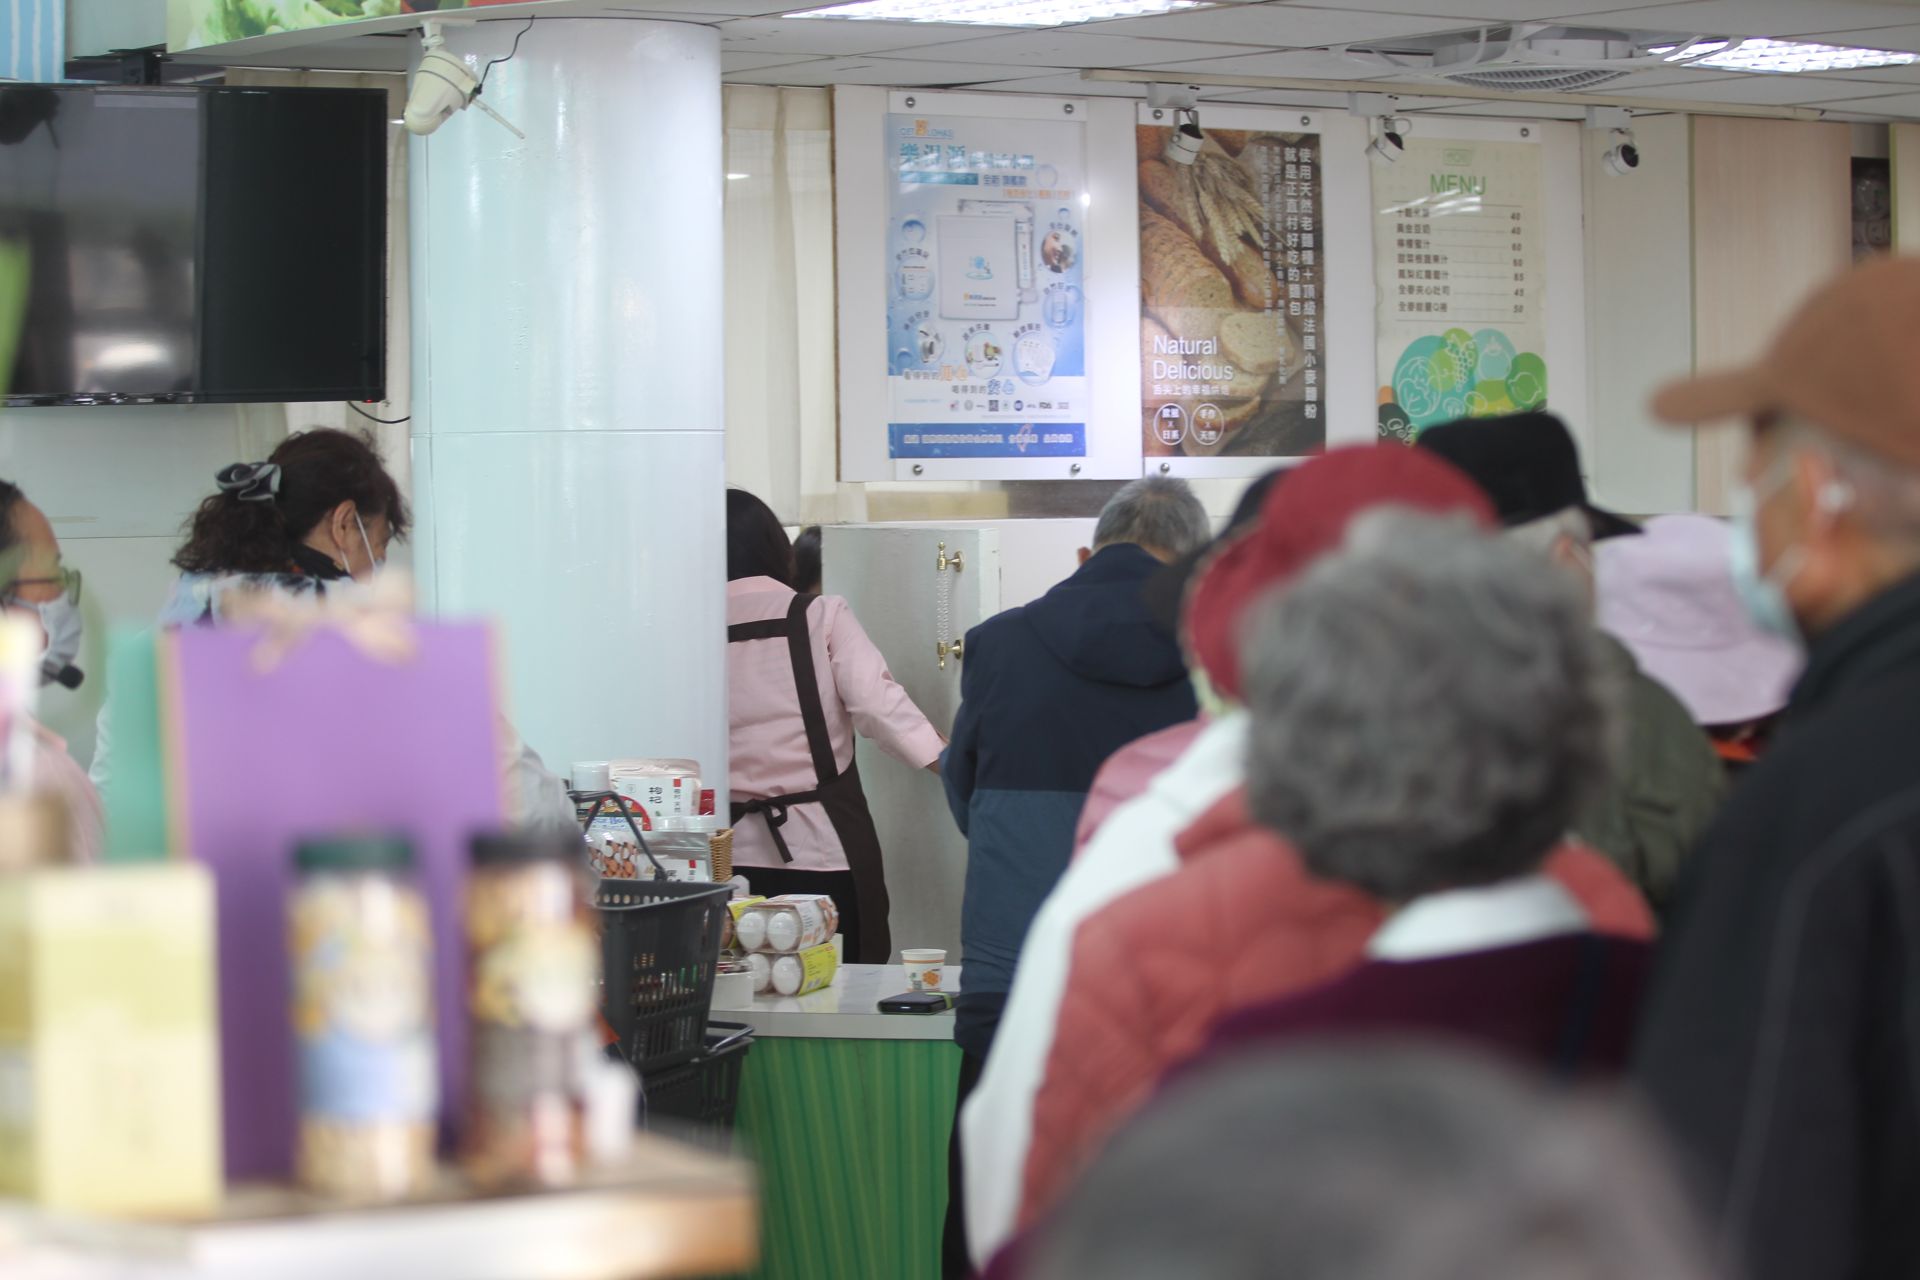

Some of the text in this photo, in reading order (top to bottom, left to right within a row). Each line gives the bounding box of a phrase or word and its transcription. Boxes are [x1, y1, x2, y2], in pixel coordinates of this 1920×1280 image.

[1430, 174, 1487, 196] MENU
[1153, 335, 1218, 355] Natural
[1153, 360, 1234, 380] Delicious
[648, 786, 663, 804] 枸杞
